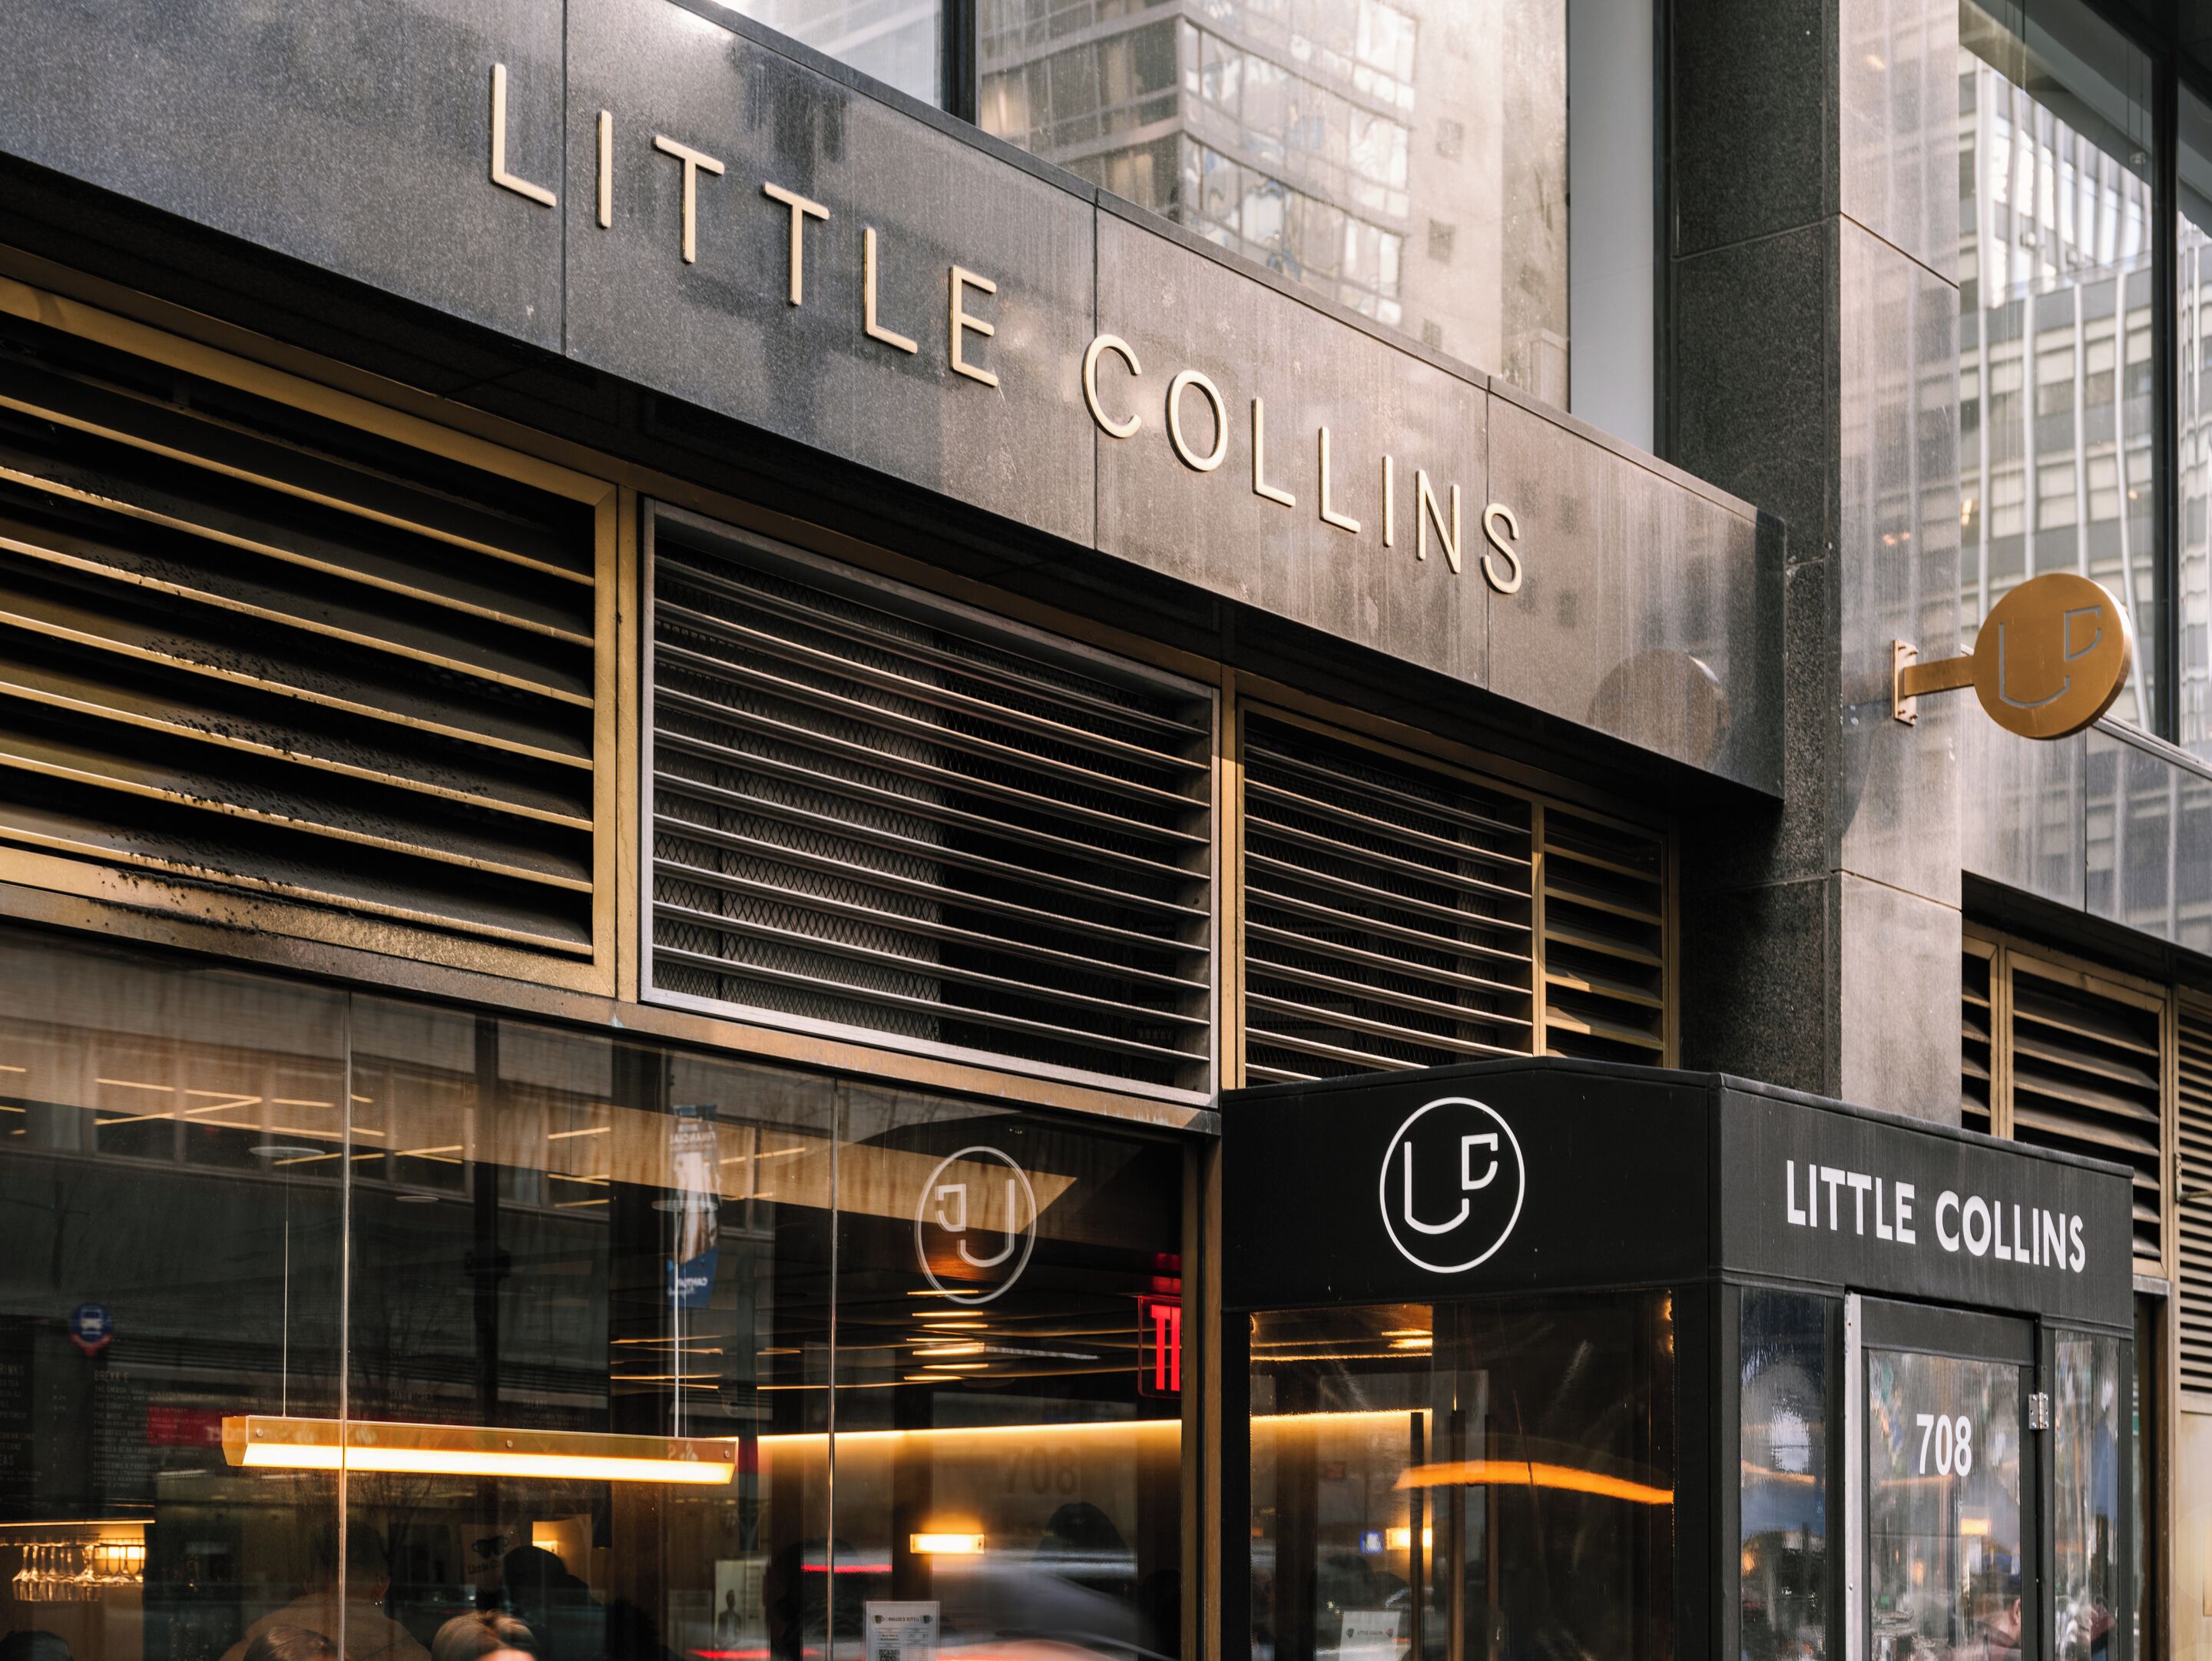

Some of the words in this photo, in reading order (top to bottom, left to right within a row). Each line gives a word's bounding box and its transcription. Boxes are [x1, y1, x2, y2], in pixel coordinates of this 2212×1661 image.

[490, 63, 999, 387] LITTLE
[1082, 333, 1522, 595] COLLINS
[1786, 1159, 1916, 1245] LITTLE
[1935, 1189, 2086, 1274] COLLINS
[1916, 1413, 1972, 1477] 708
